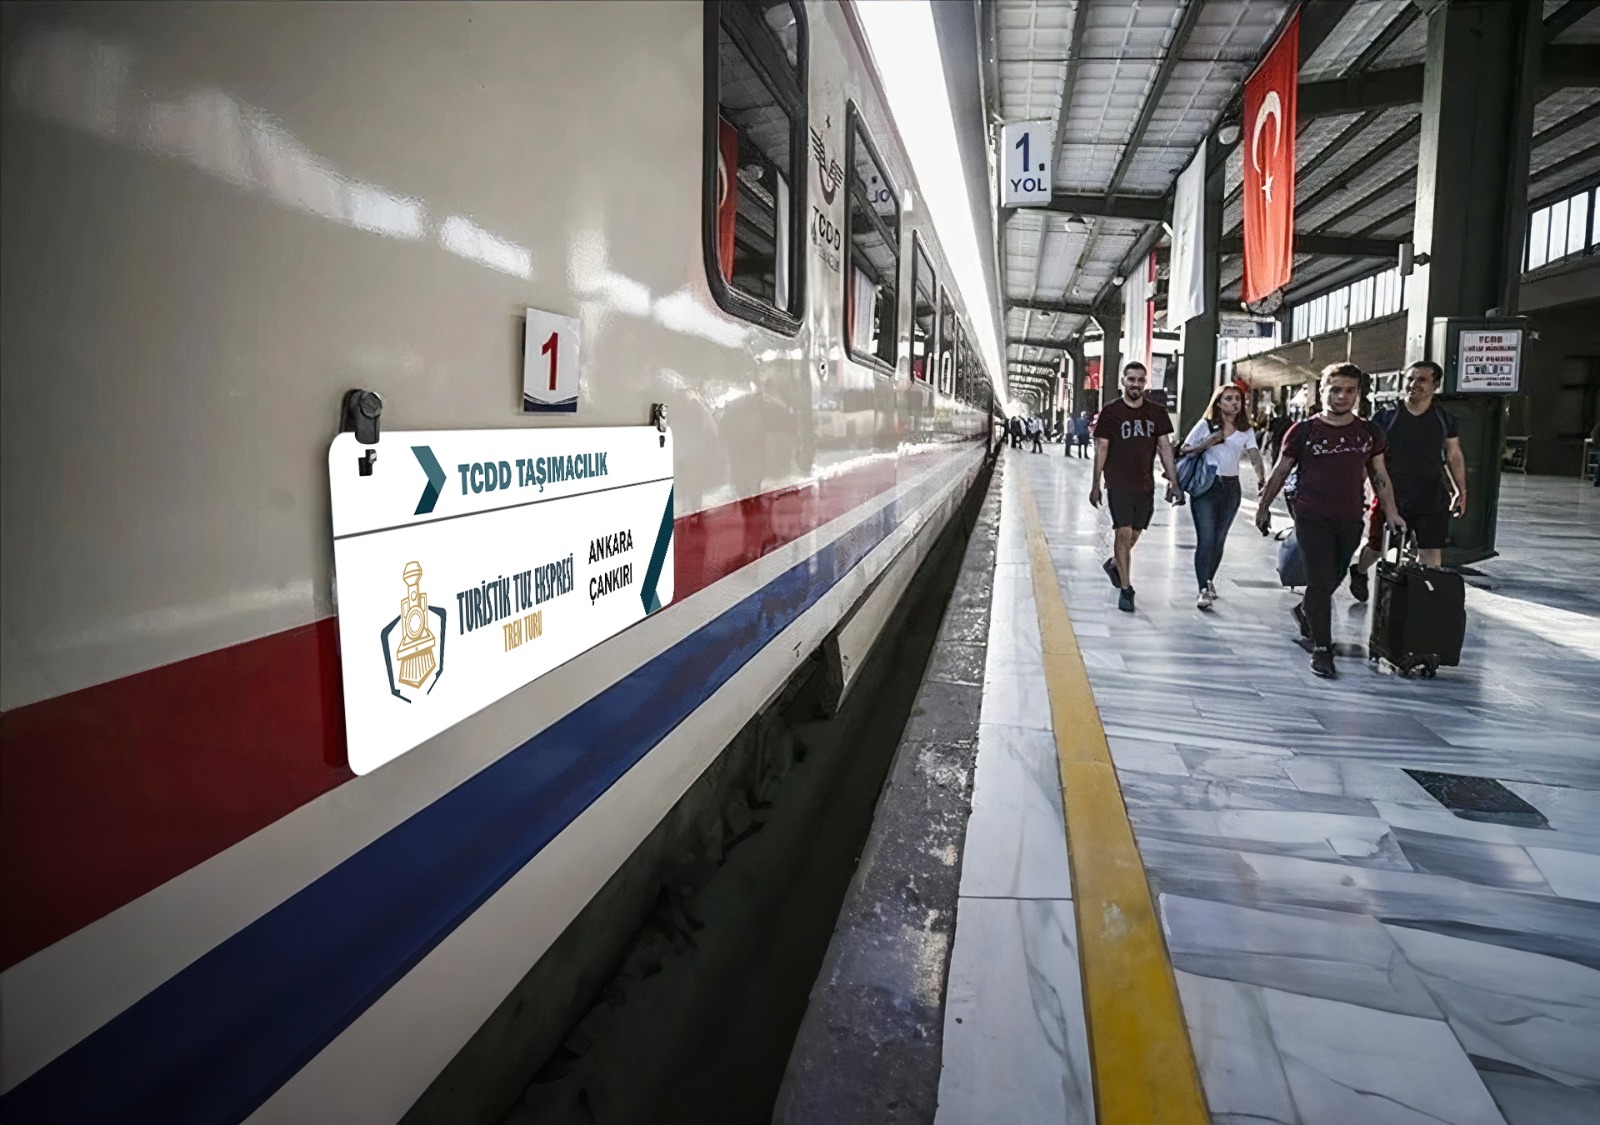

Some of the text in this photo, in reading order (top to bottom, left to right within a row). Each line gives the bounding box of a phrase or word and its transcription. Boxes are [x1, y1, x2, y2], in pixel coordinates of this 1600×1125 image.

[1016, 132, 1045, 172] 1.
[1010, 178, 1047, 193] YOL
[541, 331, 558, 390] 1
[1120, 419, 1155, 440] GAP
[458, 452, 608, 495] TCDD TAŞIMACILIK
[588, 529, 633, 564] ANKARA
[456, 552, 574, 635] TURİSTİK TUZ EKSPRESİ
[589, 563, 633, 606] ÇANKIRI
[503, 610, 543, 653] TREN TURU
